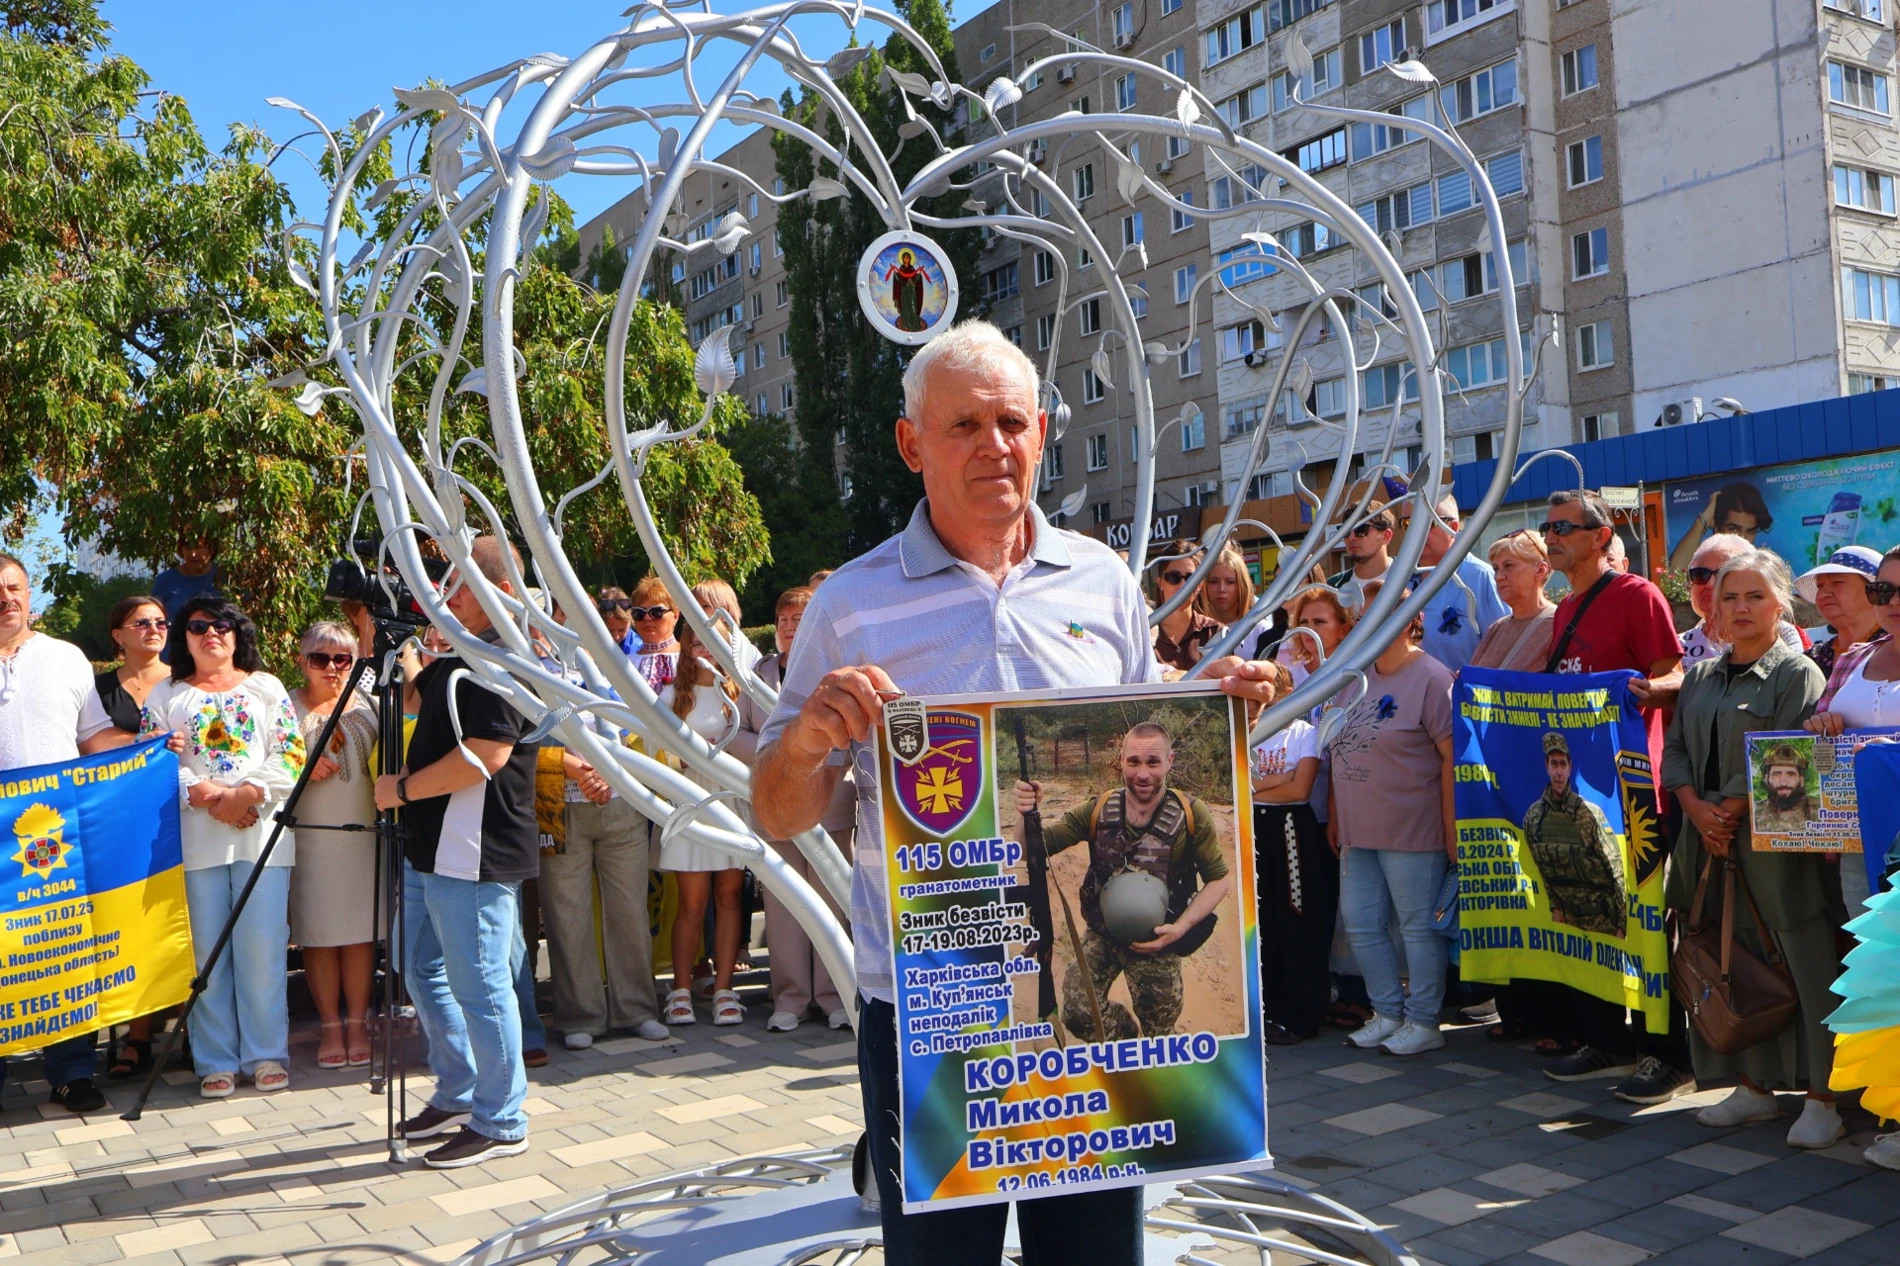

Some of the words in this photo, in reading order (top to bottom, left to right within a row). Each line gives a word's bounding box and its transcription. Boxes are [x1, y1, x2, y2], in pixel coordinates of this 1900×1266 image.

[1869, 461, 1895, 471] ЕФЕКТ
[1106, 514, 1178, 547] КОАР
[1504, 690, 1558, 711] ВИТРИМАЙ,
[944, 715, 977, 728] ВОГНЕМ
[896, 845, 942, 871] 115
[949, 838, 1021, 866] ОМБр
[1506, 844, 1518, 859] Р.
[1772, 839, 1805, 848] Кохаю!
[1808, 839, 1842, 848] Чекаю!
[1492, 861, 1524, 876] ОБЛ.
[17, 887, 42, 902] в/ч
[42, 878, 77, 897] 3044
[899, 875, 1017, 899] гранатометник
[5, 914, 42, 931] Зник
[44, 901, 94, 923] 17.07.25
[901, 912, 946, 930] Зник
[949, 903, 1025, 925] безвісти
[8, 930, 121, 968] Новоекономічне
[23, 923, 83, 946] поблизу
[903, 924, 1038, 954] 17-19.08.2023р.
[1528, 927, 1593, 963] ВІТАЛІЙ
[0, 964, 61, 988] онецька
[64, 945, 120, 972] область)
[906, 963, 999, 988] Харківська
[1004, 956, 1040, 973] обл.
[19, 991, 61, 1016] ТЕБЕ
[64, 965, 136, 1003] ЧЕКАЄМО
[909, 996, 927, 1010] м.
[0, 1001, 98, 1044] ЗНАЙДЕМО!
[910, 1006, 995, 1032] неподалік
[911, 1042, 928, 1054] с.
[933, 1022, 1052, 1052] Петропавлівка
[966, 1033, 1218, 1091] КОРОБЧЕНКО
[968, 1090, 1108, 1130] Микола
[969, 1122, 1174, 1169] Вікторович
[997, 1164, 1103, 1192] 12.06.1984
